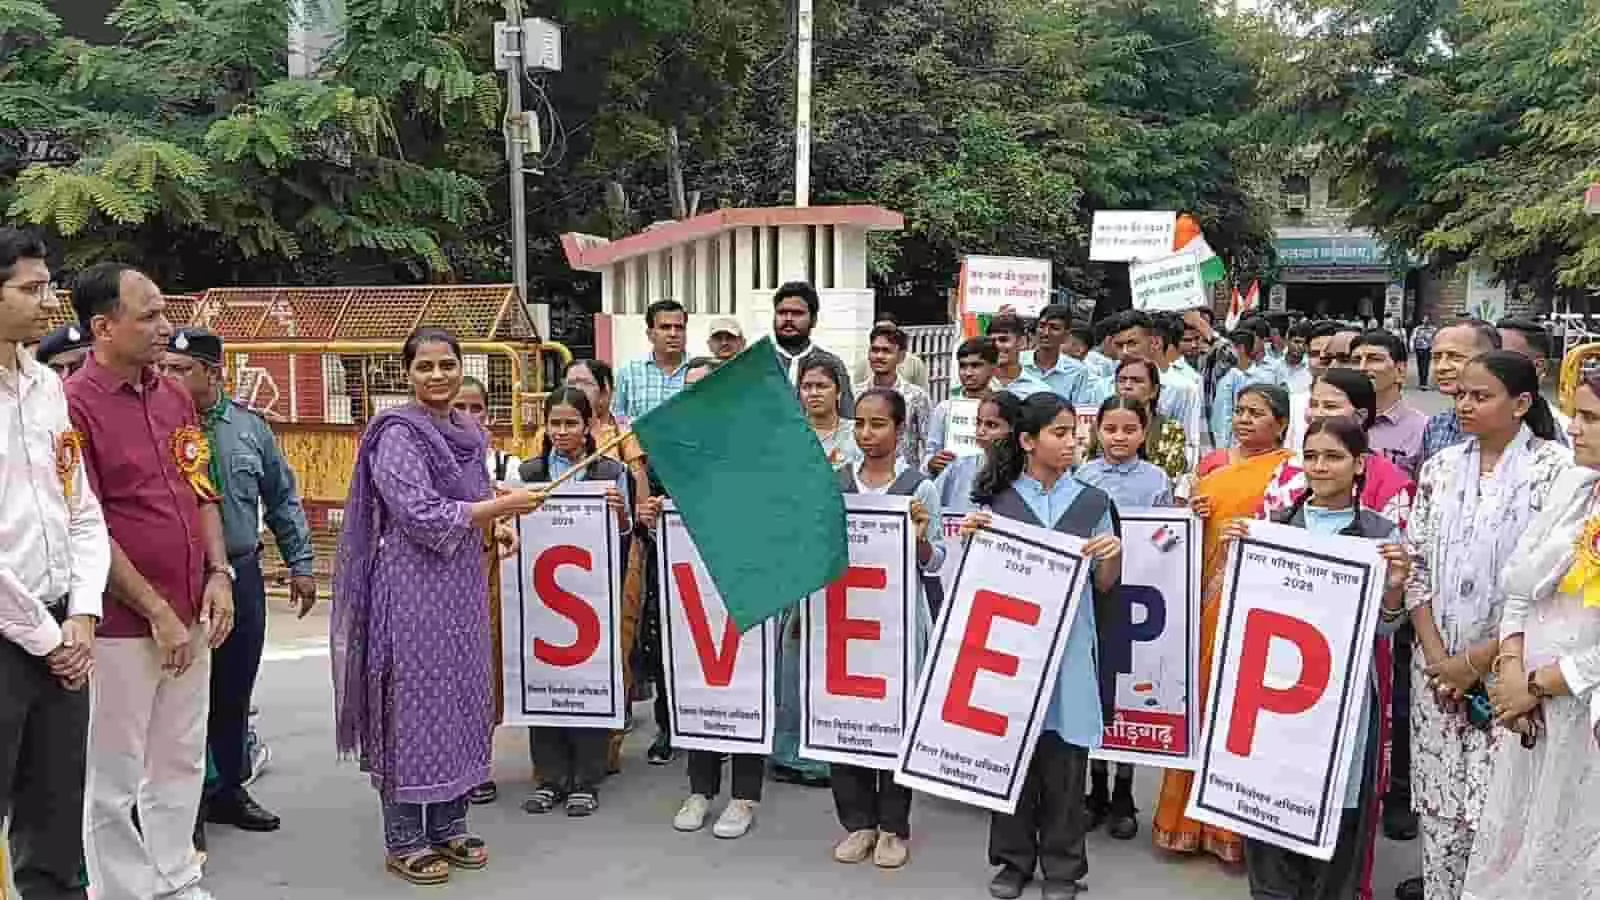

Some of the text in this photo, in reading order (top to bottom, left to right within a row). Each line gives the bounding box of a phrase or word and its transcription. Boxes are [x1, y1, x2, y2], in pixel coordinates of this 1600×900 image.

[533, 544, 601, 668] S
[671, 561, 743, 688] V
[826, 567, 886, 698] E
[941, 588, 1042, 738] E
[1225, 606, 1333, 758] P
